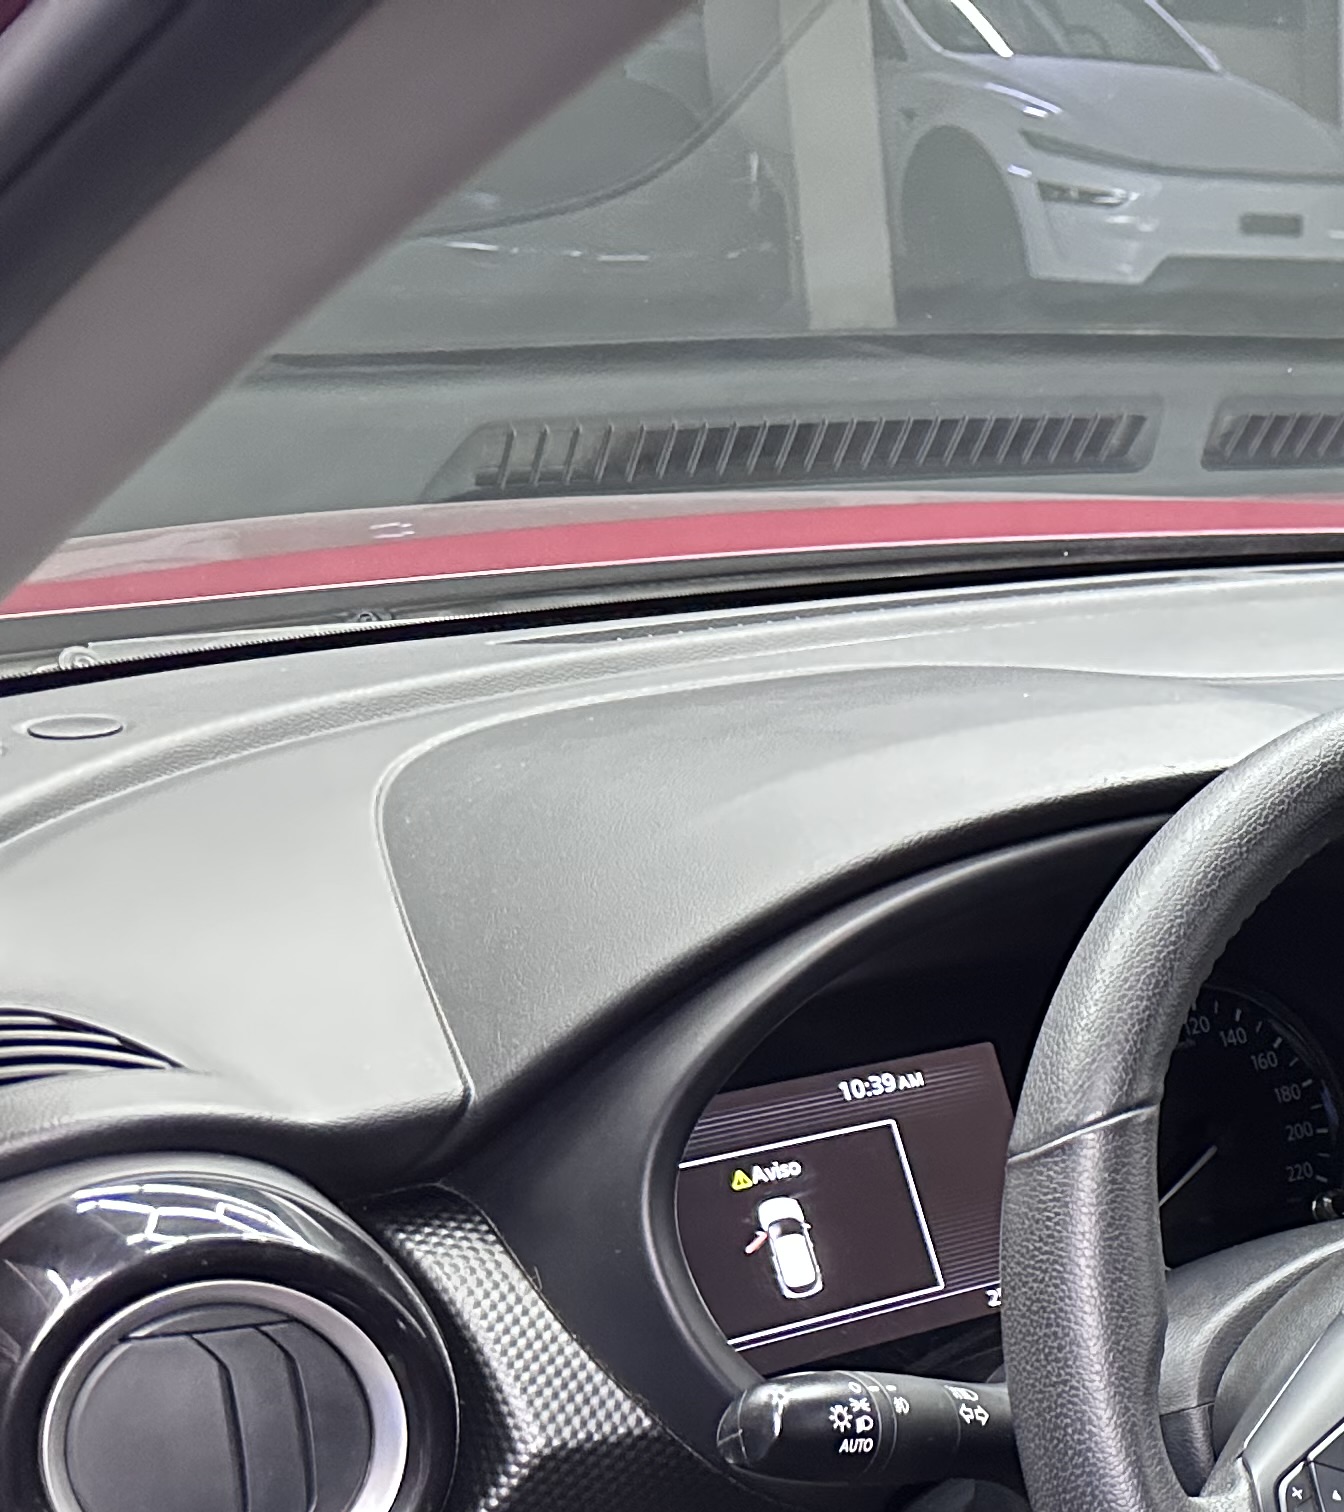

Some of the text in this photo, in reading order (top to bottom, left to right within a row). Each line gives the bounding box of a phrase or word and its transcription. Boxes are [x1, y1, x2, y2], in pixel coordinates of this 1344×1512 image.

[1184, 1016, 1210, 1036] 120
[1219, 1027, 1247, 1047] 140
[1250, 1050, 1278, 1071] 160
[838, 1071, 925, 1101] 10:39 AM
[1274, 1083, 1301, 1104] 180
[1285, 1121, 1313, 1141] 200
[752, 1160, 802, 1185] Aviso
[1285, 1161, 1313, 1182] 220
[838, 1437, 874, 1455] AUTO
